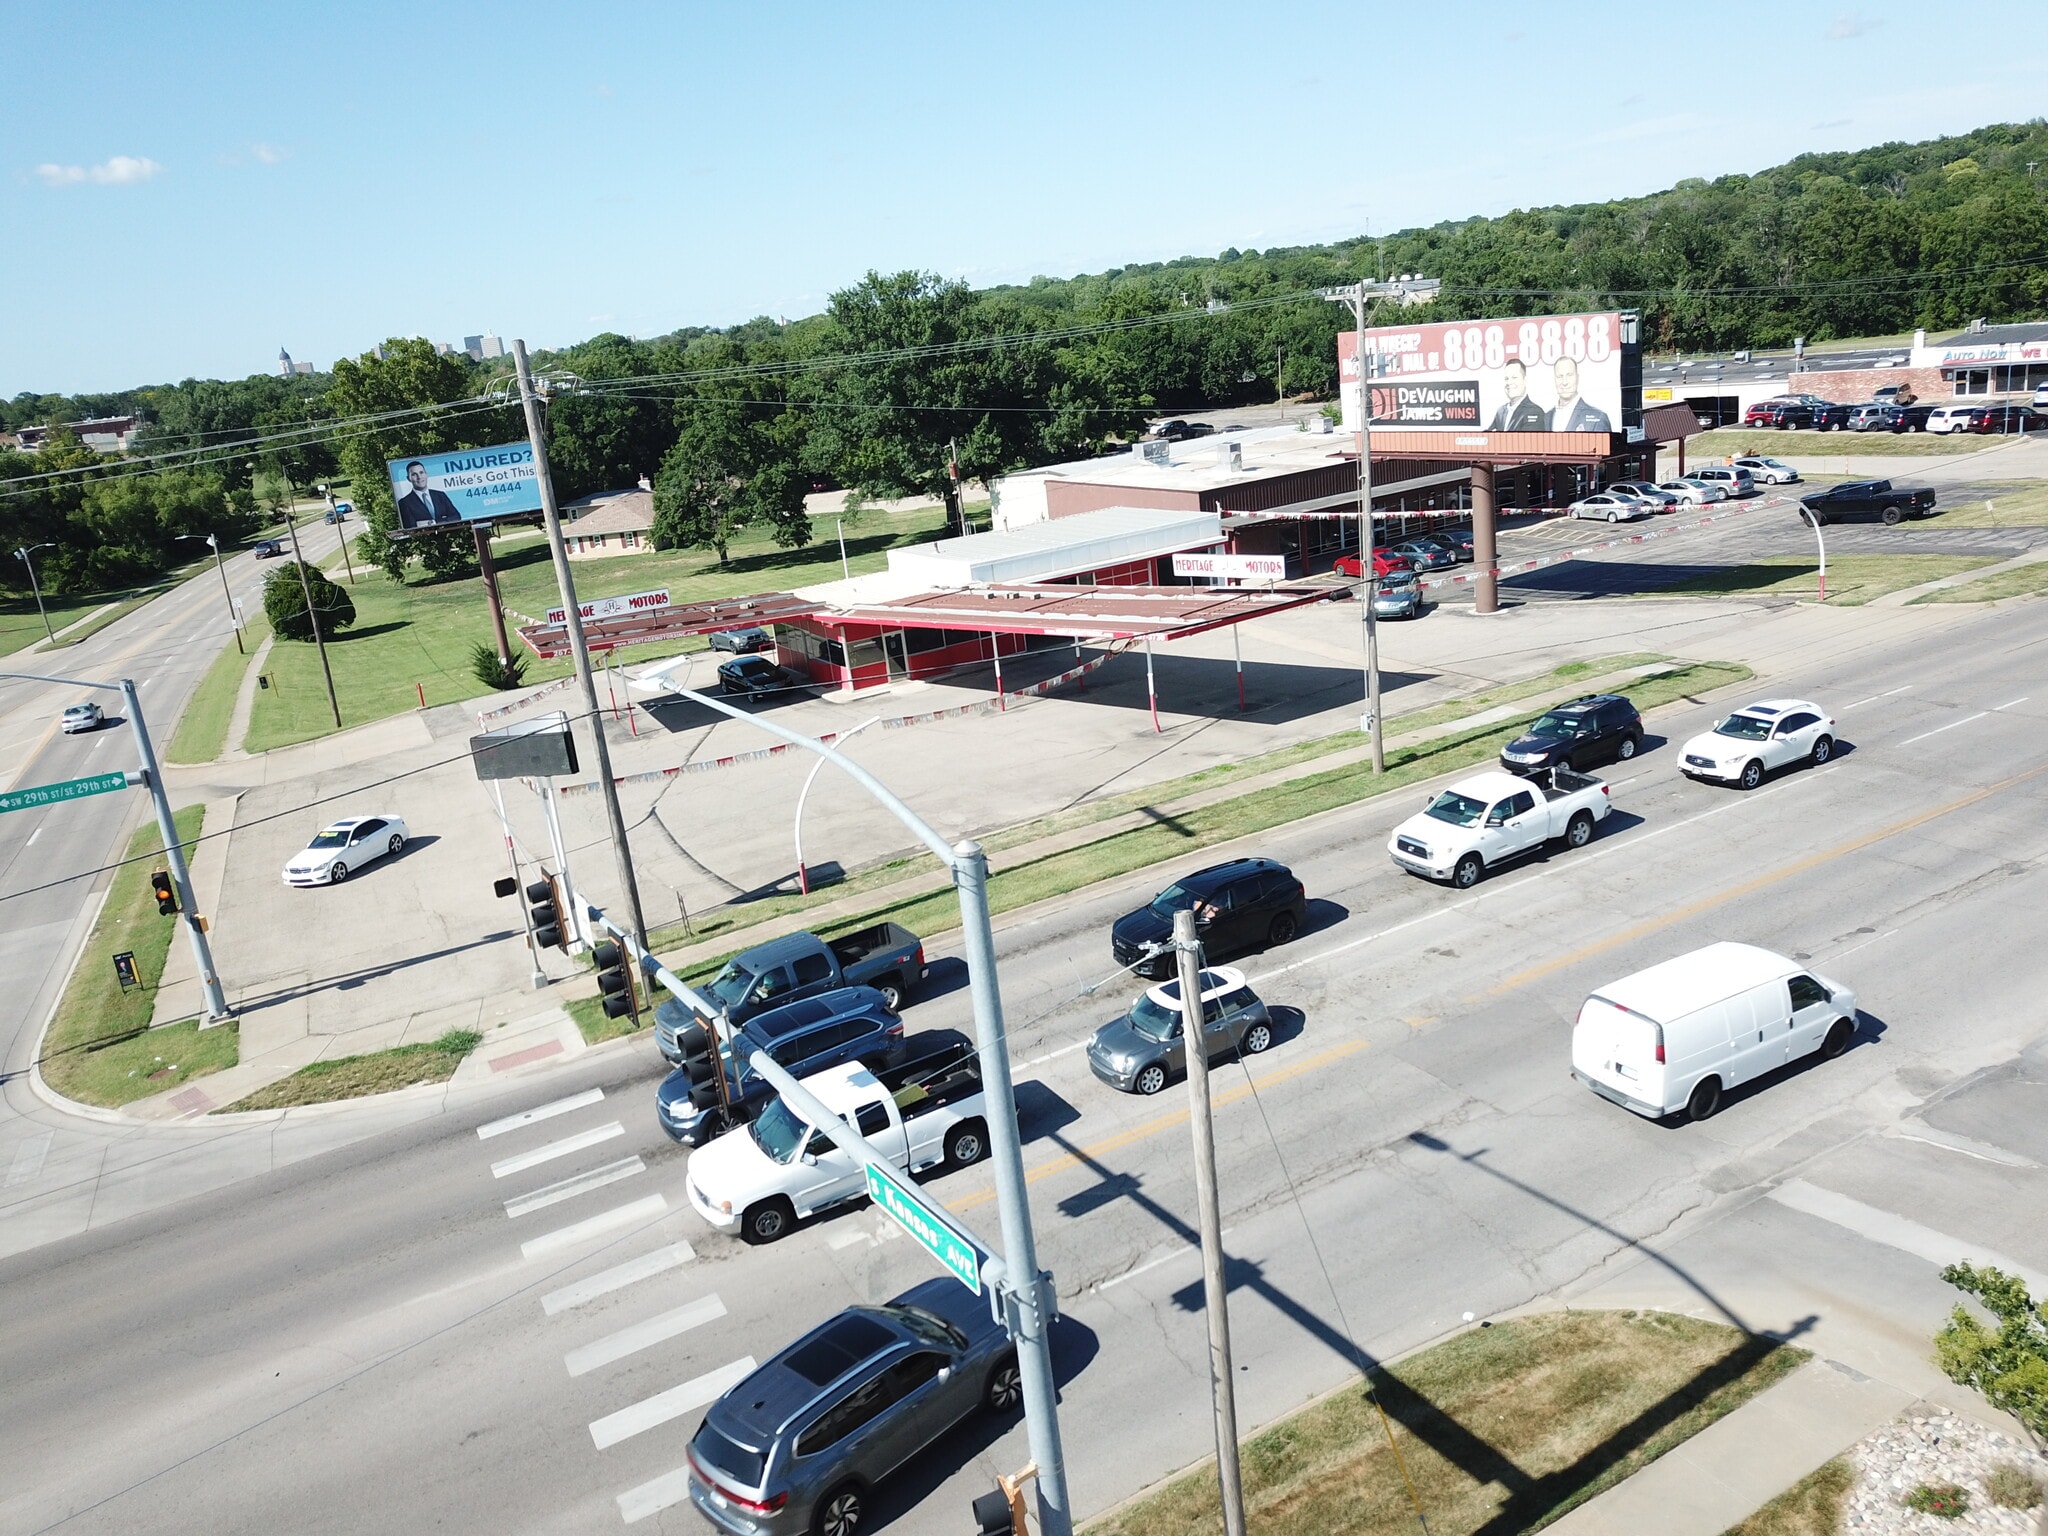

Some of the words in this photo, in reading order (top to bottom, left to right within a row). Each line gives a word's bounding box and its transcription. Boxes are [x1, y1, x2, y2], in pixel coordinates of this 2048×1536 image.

[1443, 316, 1611, 371] 888-8888
[2022, 348, 2041, 358] WE
[1445, 407, 1476, 419] WINS!
[444, 450, 532, 473] INJURED?
[485, 472, 508, 482] Got
[510, 467, 535, 478] This
[466, 482, 522, 498] 444.4444
[1175, 559, 1214, 571] HERITAGE
[1245, 561, 1282, 573] MOTORS
[629, 593, 668, 609] MOTORS
[10, 798, 22, 806] SW
[24, 792, 48, 804] 29th
[50, 787, 75, 799] ST/SE
[76, 781, 100, 794] 29th
[102, 780, 111, 788] ST
[870, 1177, 880, 1195] S
[884, 1185, 939, 1248] Kansas
[947, 1245, 974, 1280] Ave
